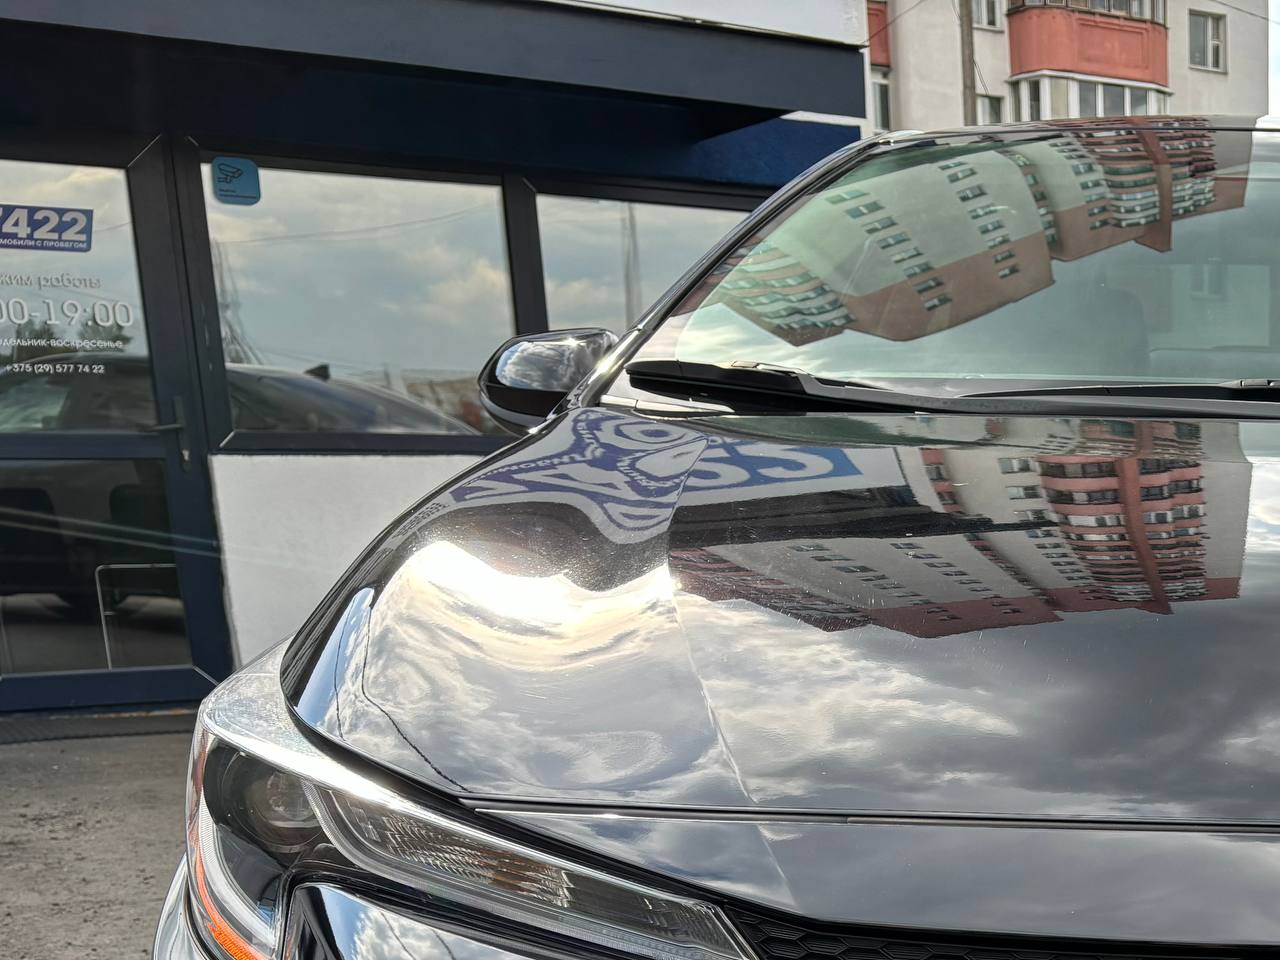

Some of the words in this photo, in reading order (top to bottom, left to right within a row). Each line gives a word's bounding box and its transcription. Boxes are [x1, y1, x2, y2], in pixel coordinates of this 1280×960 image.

[0, 207, 86, 241] 422
[6, 363, 33, 372] +375
[34, 363, 54, 374] (29)
[56, 364, 75, 373] 577
[77, 364, 90, 373] 74
[92, 364, 105, 373] 22
